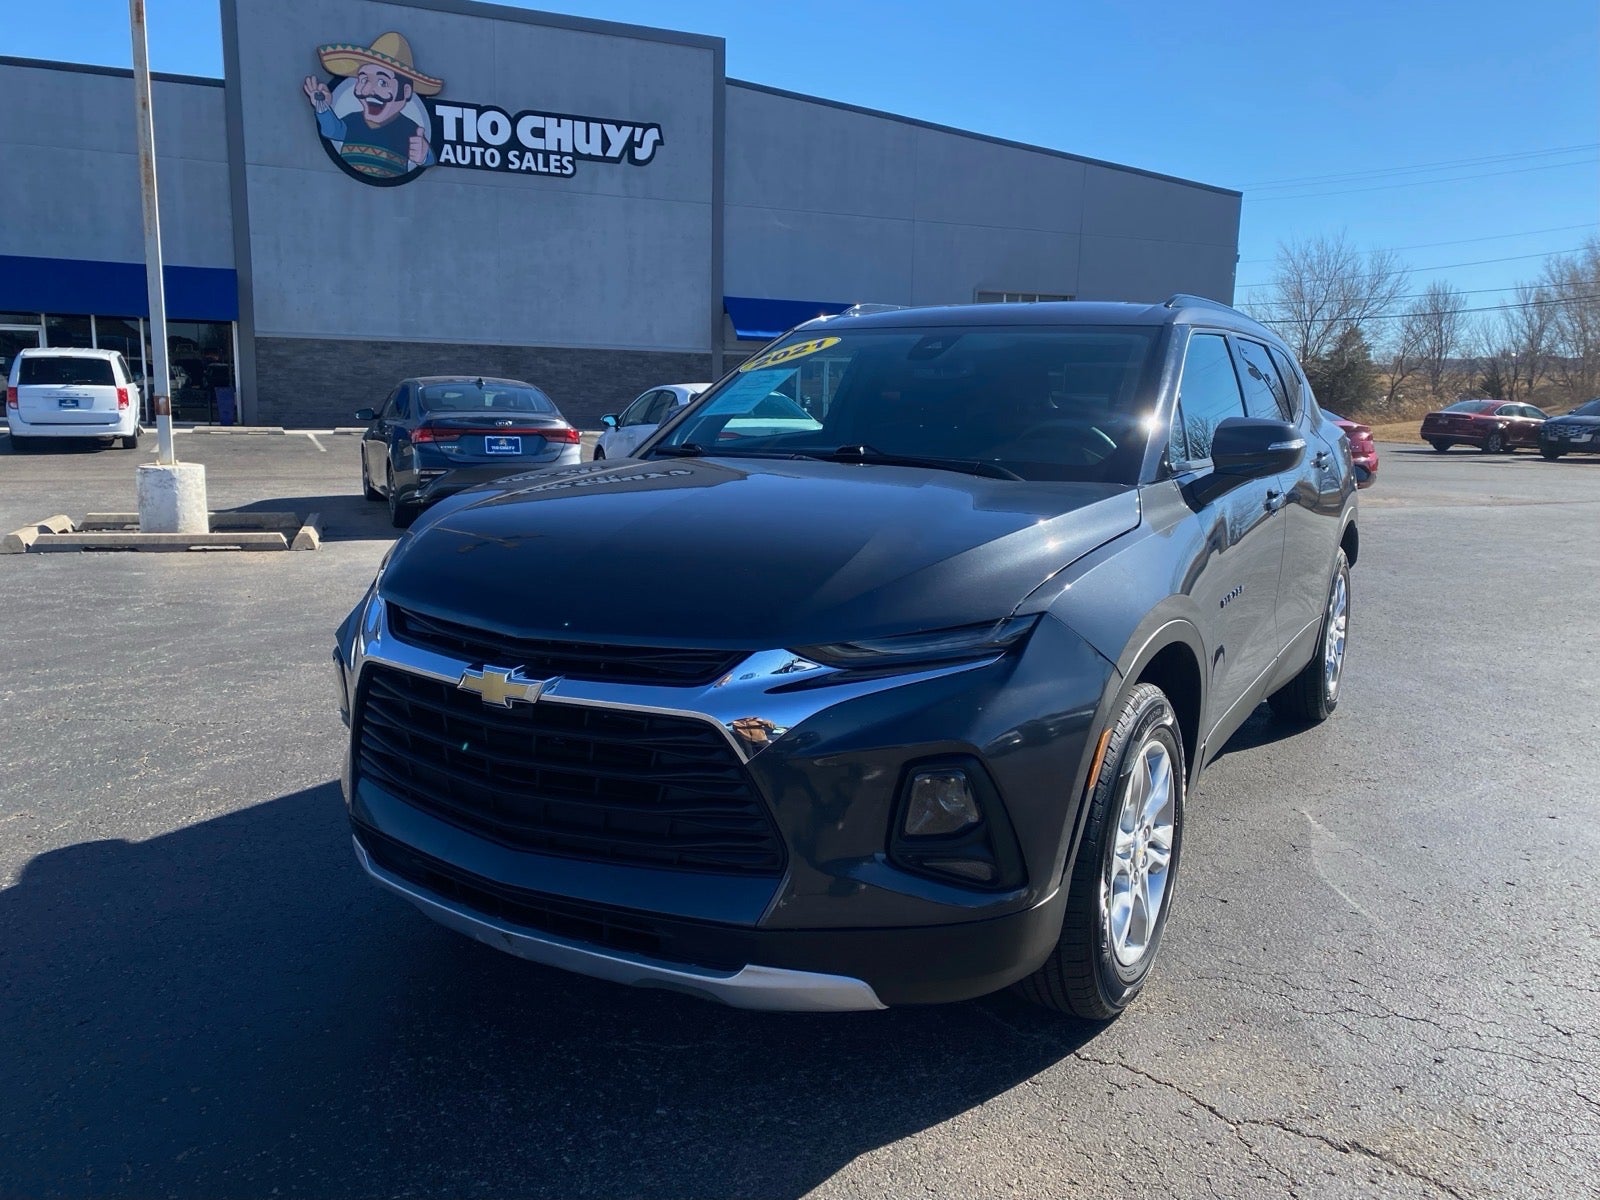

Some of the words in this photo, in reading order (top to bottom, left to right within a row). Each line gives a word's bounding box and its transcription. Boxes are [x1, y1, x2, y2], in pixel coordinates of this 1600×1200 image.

[435, 105, 510, 146] TIO
[516, 115, 660, 161] CHUY'S
[439, 143, 500, 167] AUTO
[508, 149, 574, 174] SALES
[751, 339, 825, 368] 2021
